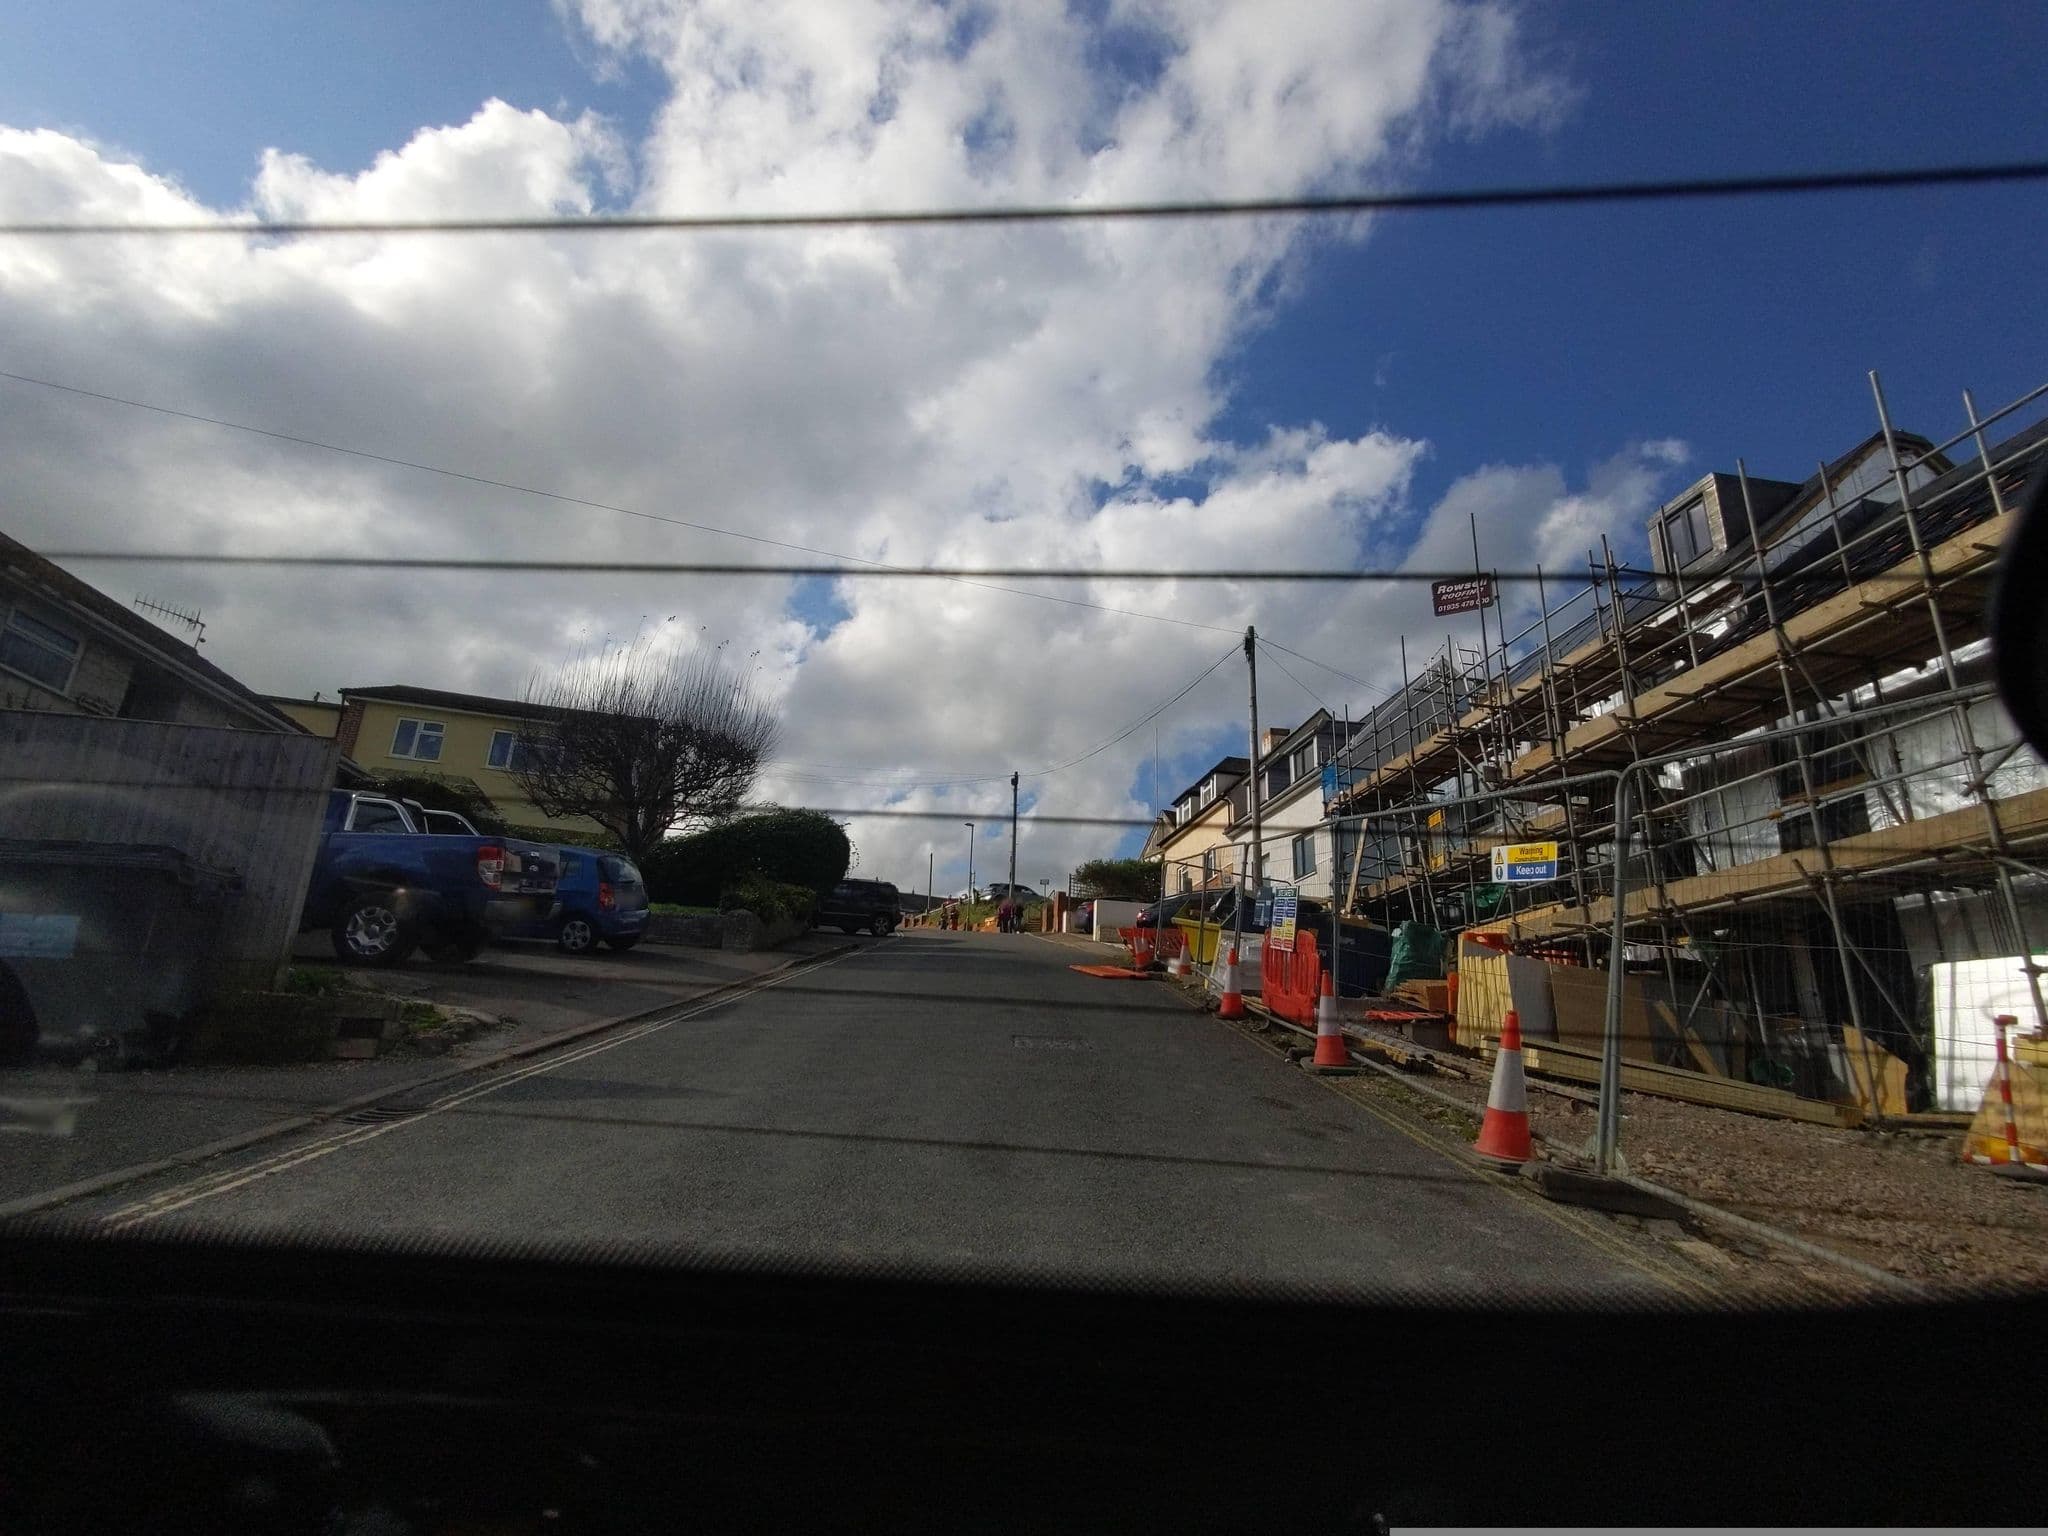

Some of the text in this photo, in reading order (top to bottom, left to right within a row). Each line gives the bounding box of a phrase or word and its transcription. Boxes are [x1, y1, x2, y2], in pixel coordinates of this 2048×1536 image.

[1518, 847, 1543, 855] Warning
[1516, 864, 1547, 875] Keep out
